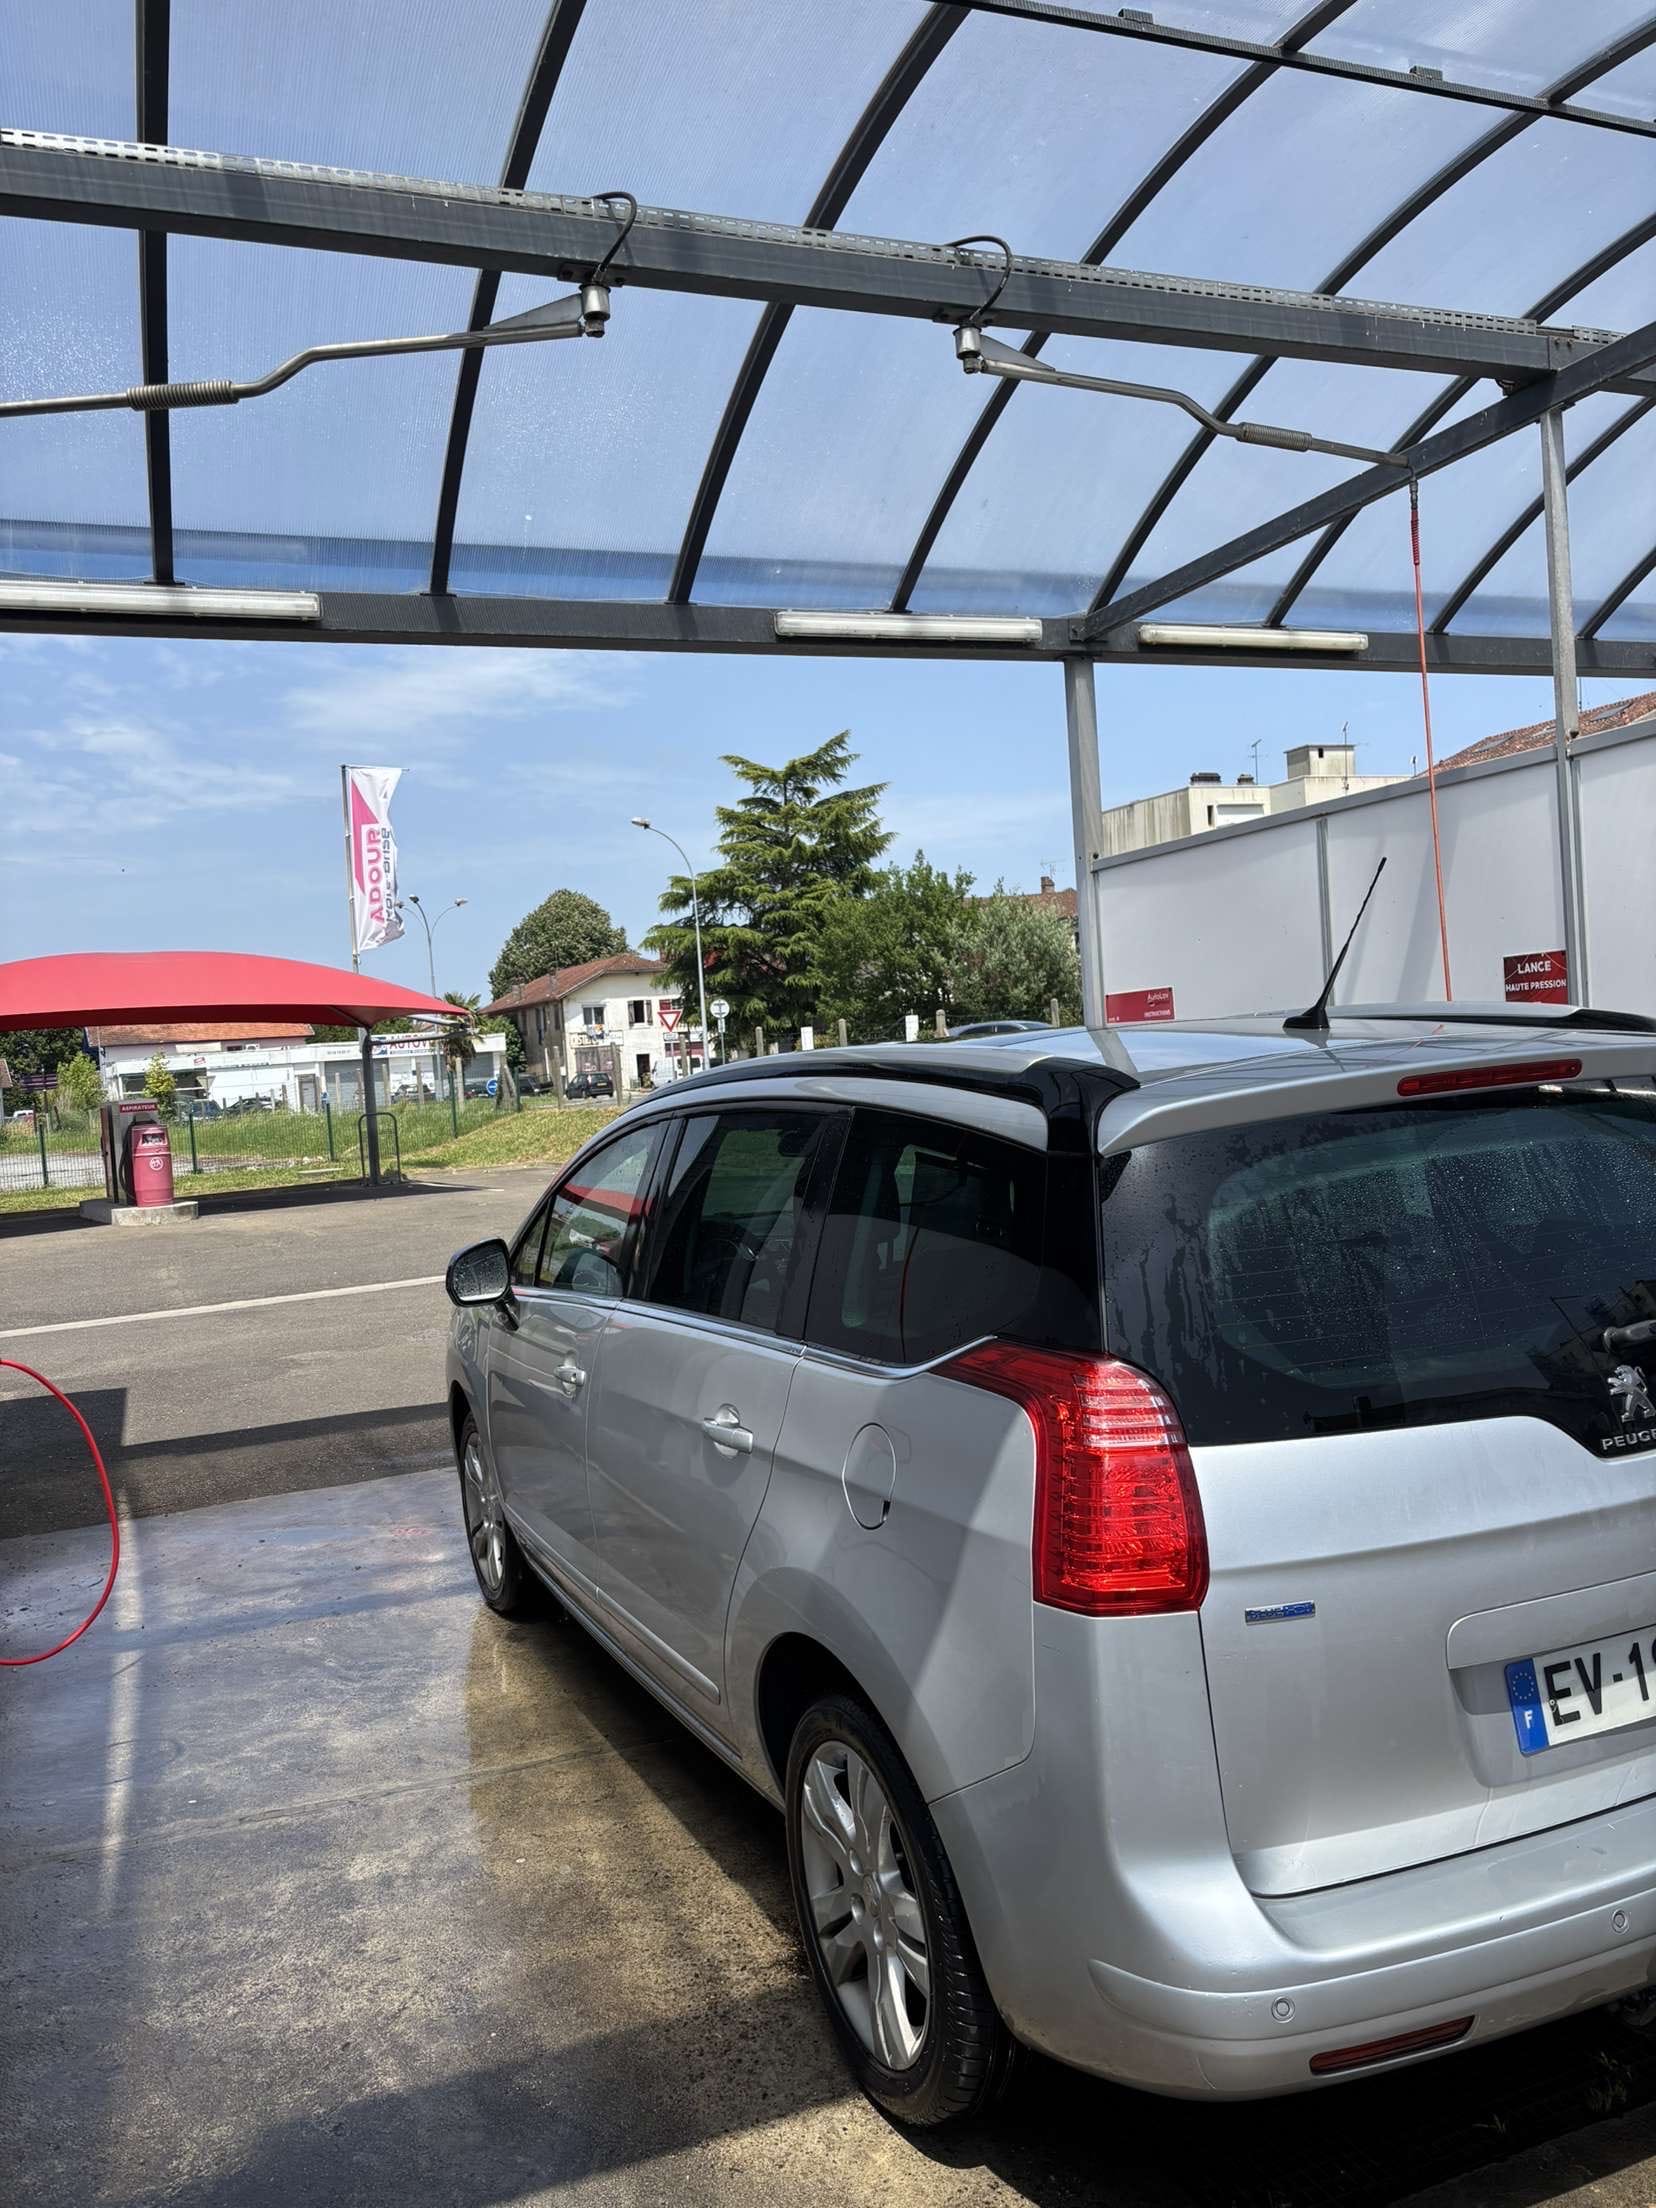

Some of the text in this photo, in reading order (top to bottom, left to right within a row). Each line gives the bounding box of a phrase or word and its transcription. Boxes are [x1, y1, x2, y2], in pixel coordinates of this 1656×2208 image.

[366, 828, 385, 924] ADOUR
[1517, 960, 1552, 974] LANCE
[1505, 979, 1567, 992] HAUTE PRESSION
[121, 1103, 156, 1111] ASPIRATEUR
[1544, 1638, 1656, 1727] EV-1
[1523, 1710, 1533, 1729] F
